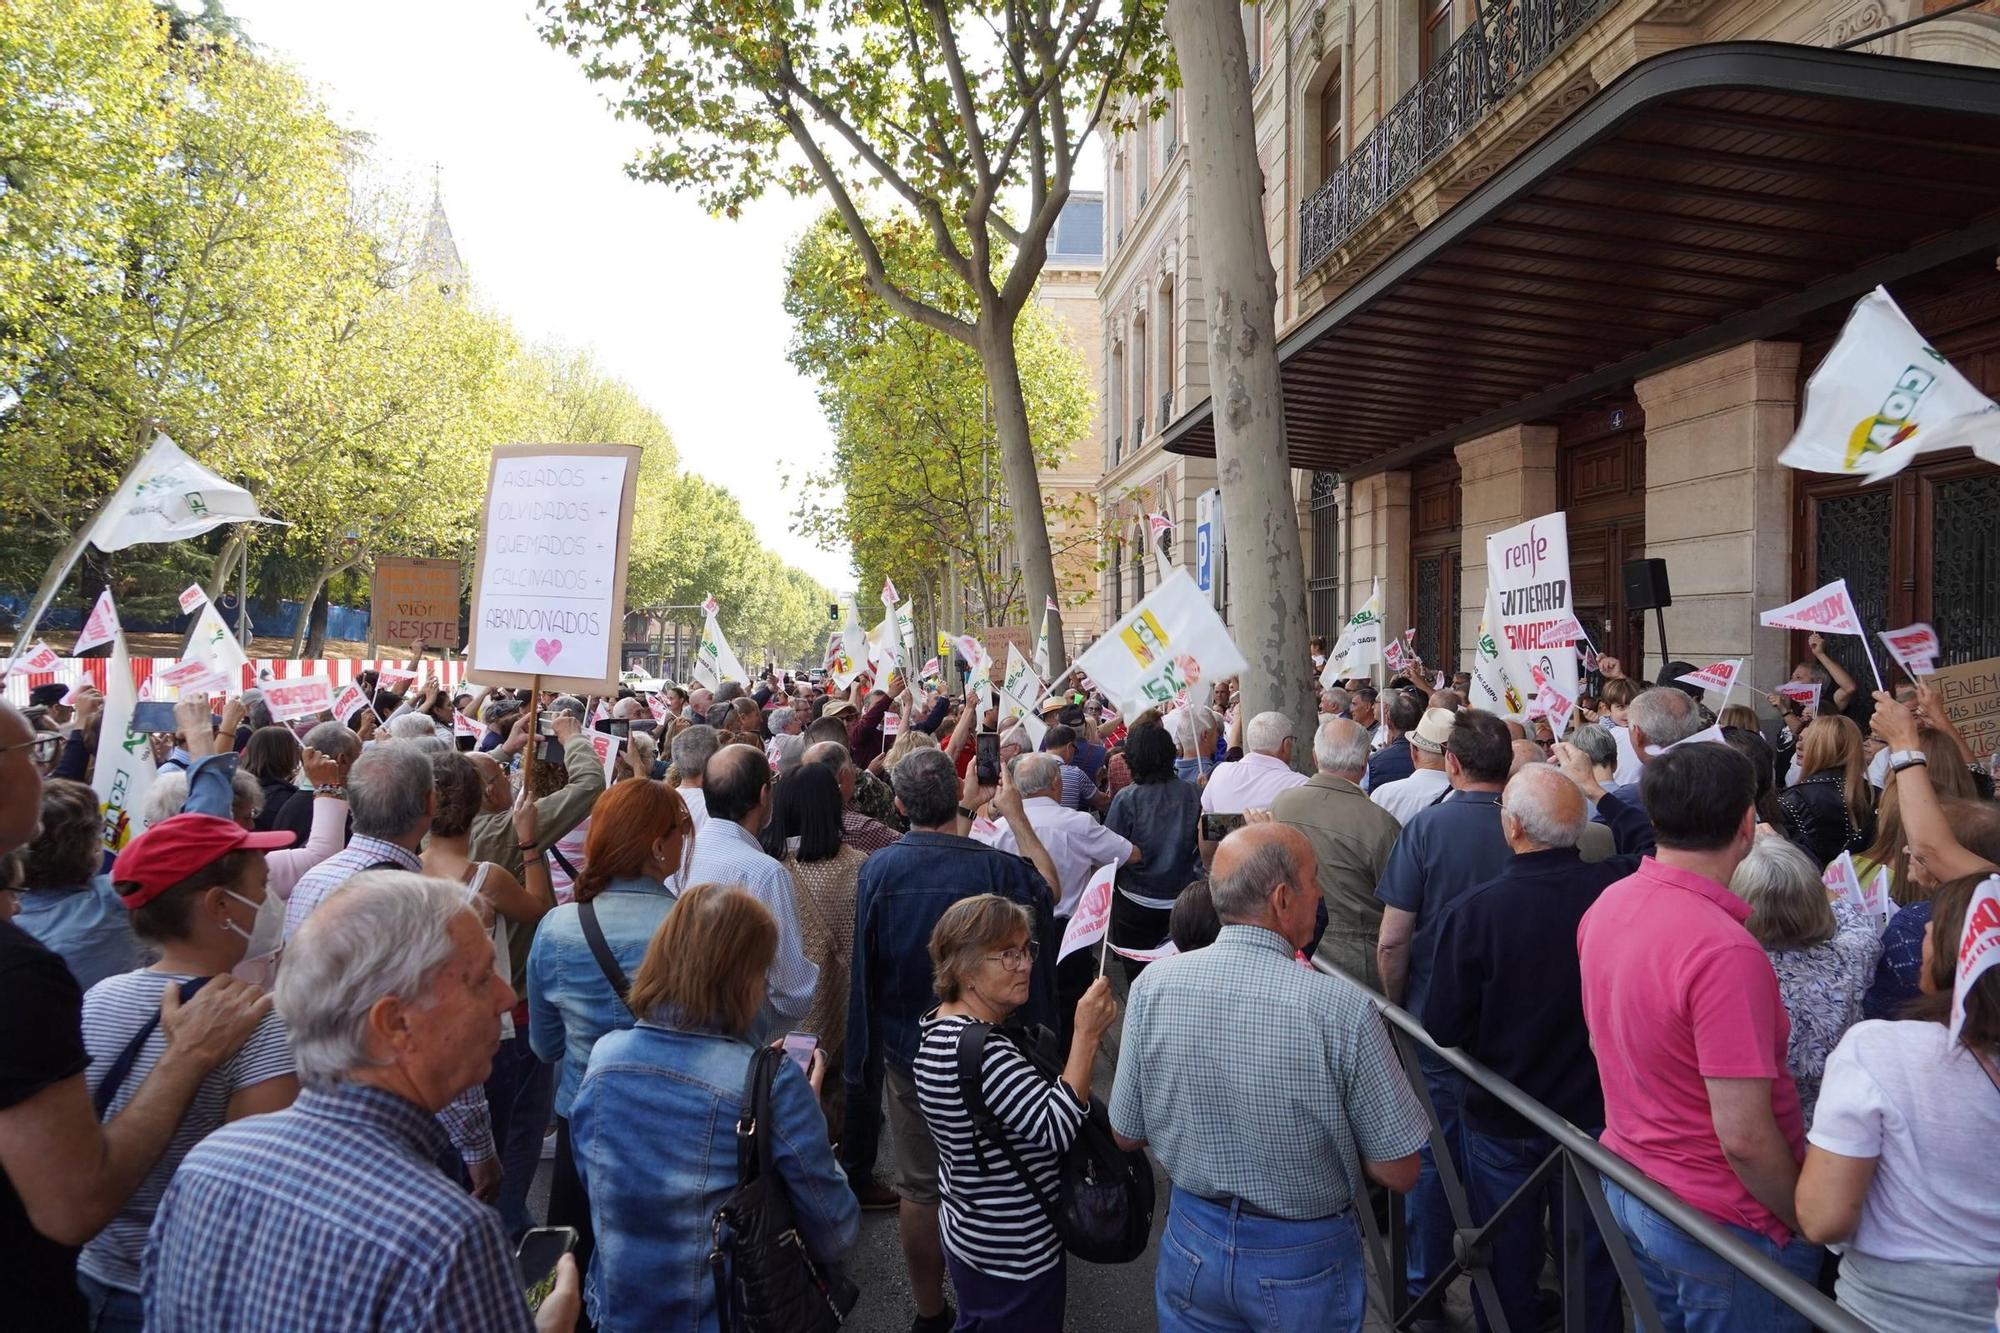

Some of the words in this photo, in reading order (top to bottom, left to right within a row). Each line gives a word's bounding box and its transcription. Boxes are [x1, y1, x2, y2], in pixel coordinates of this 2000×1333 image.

[1612, 412, 1621, 427] 4
[502, 468, 585, 488] AISLADOS
[498, 501, 590, 521] OLVIDADOS
[496, 535, 587, 556] QUEMADOS
[1505, 524, 1548, 579] renfe
[1198, 530, 1208, 586] P
[492, 567, 588, 590] CALCINADOS
[388, 620, 456, 641] RESISTE
[486, 608, 600, 636] ABANDONADOS
[1481, 633, 1499, 660] UPA
[1930, 672, 2000, 699] TENEM
[1974, 720, 1996, 733] LOS
